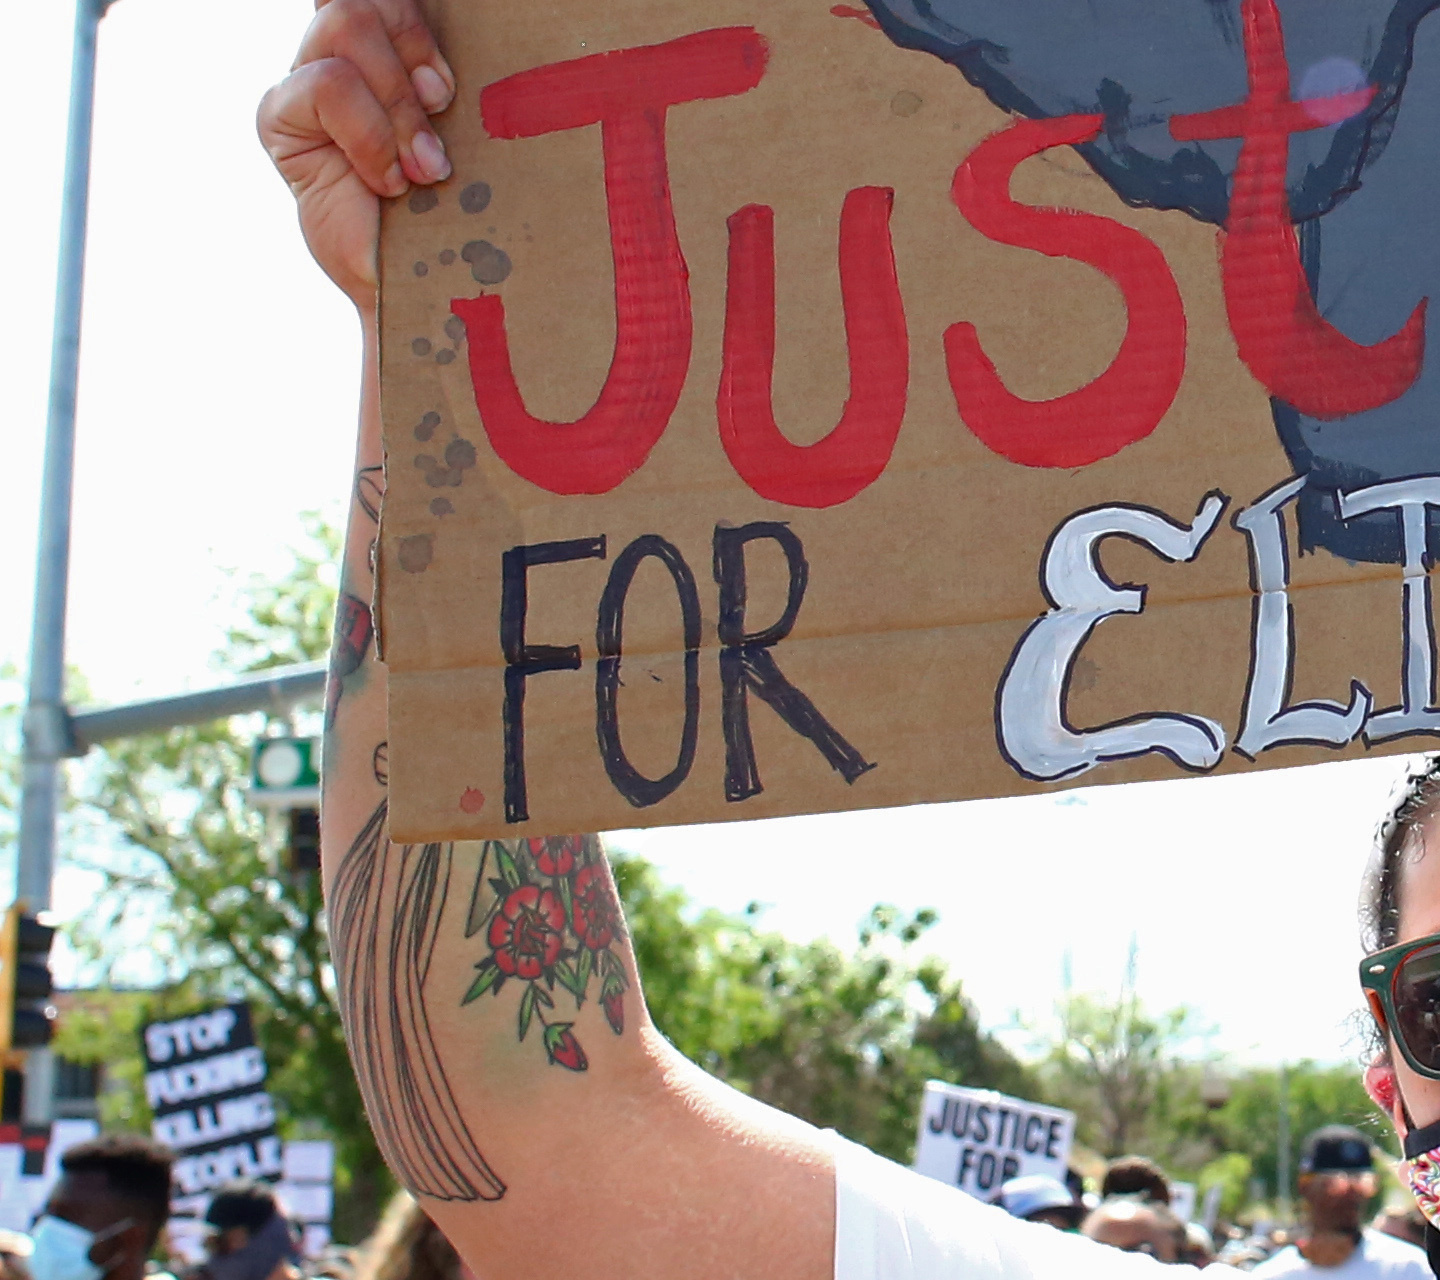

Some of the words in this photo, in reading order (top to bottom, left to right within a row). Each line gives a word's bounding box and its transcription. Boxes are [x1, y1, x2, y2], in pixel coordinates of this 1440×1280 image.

[499, 519, 879, 825] FOR
[145, 1008, 237, 1063] STOP
[929, 1097, 1063, 1160] JUSTICE
[957, 1147, 1021, 1192] FOR
